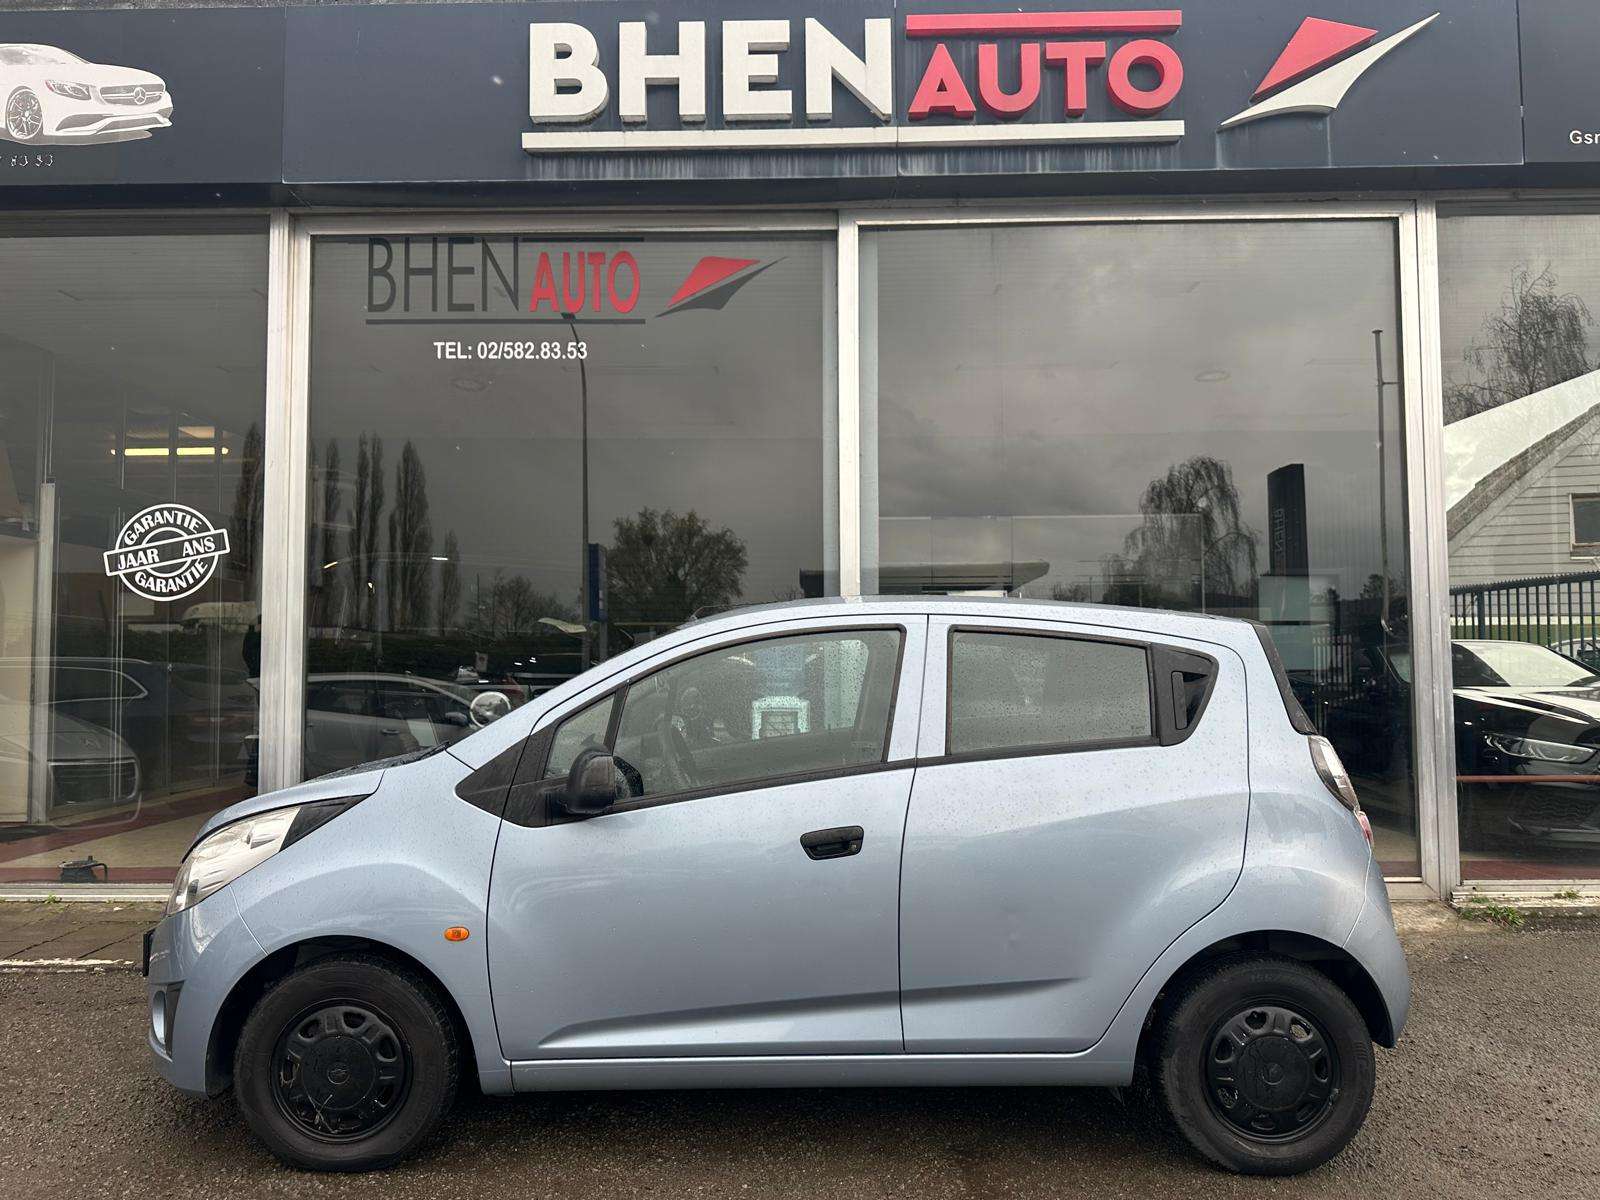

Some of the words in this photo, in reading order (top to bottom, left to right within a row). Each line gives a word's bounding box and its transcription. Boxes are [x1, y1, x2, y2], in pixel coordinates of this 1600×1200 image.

[530, 17, 892, 123] BHEN
[908, 39, 1184, 119] AUTO
[367, 236, 519, 312] BHEN
[529, 250, 640, 313] AUTO
[433, 341, 473, 360] TEL:
[477, 341, 588, 360] 02/582.83.53
[124, 510, 202, 545] GARANTIE
[118, 548, 160, 570] JAAR
[182, 536, 216, 557] ANS
[134, 559, 208, 593] GARANTIE
